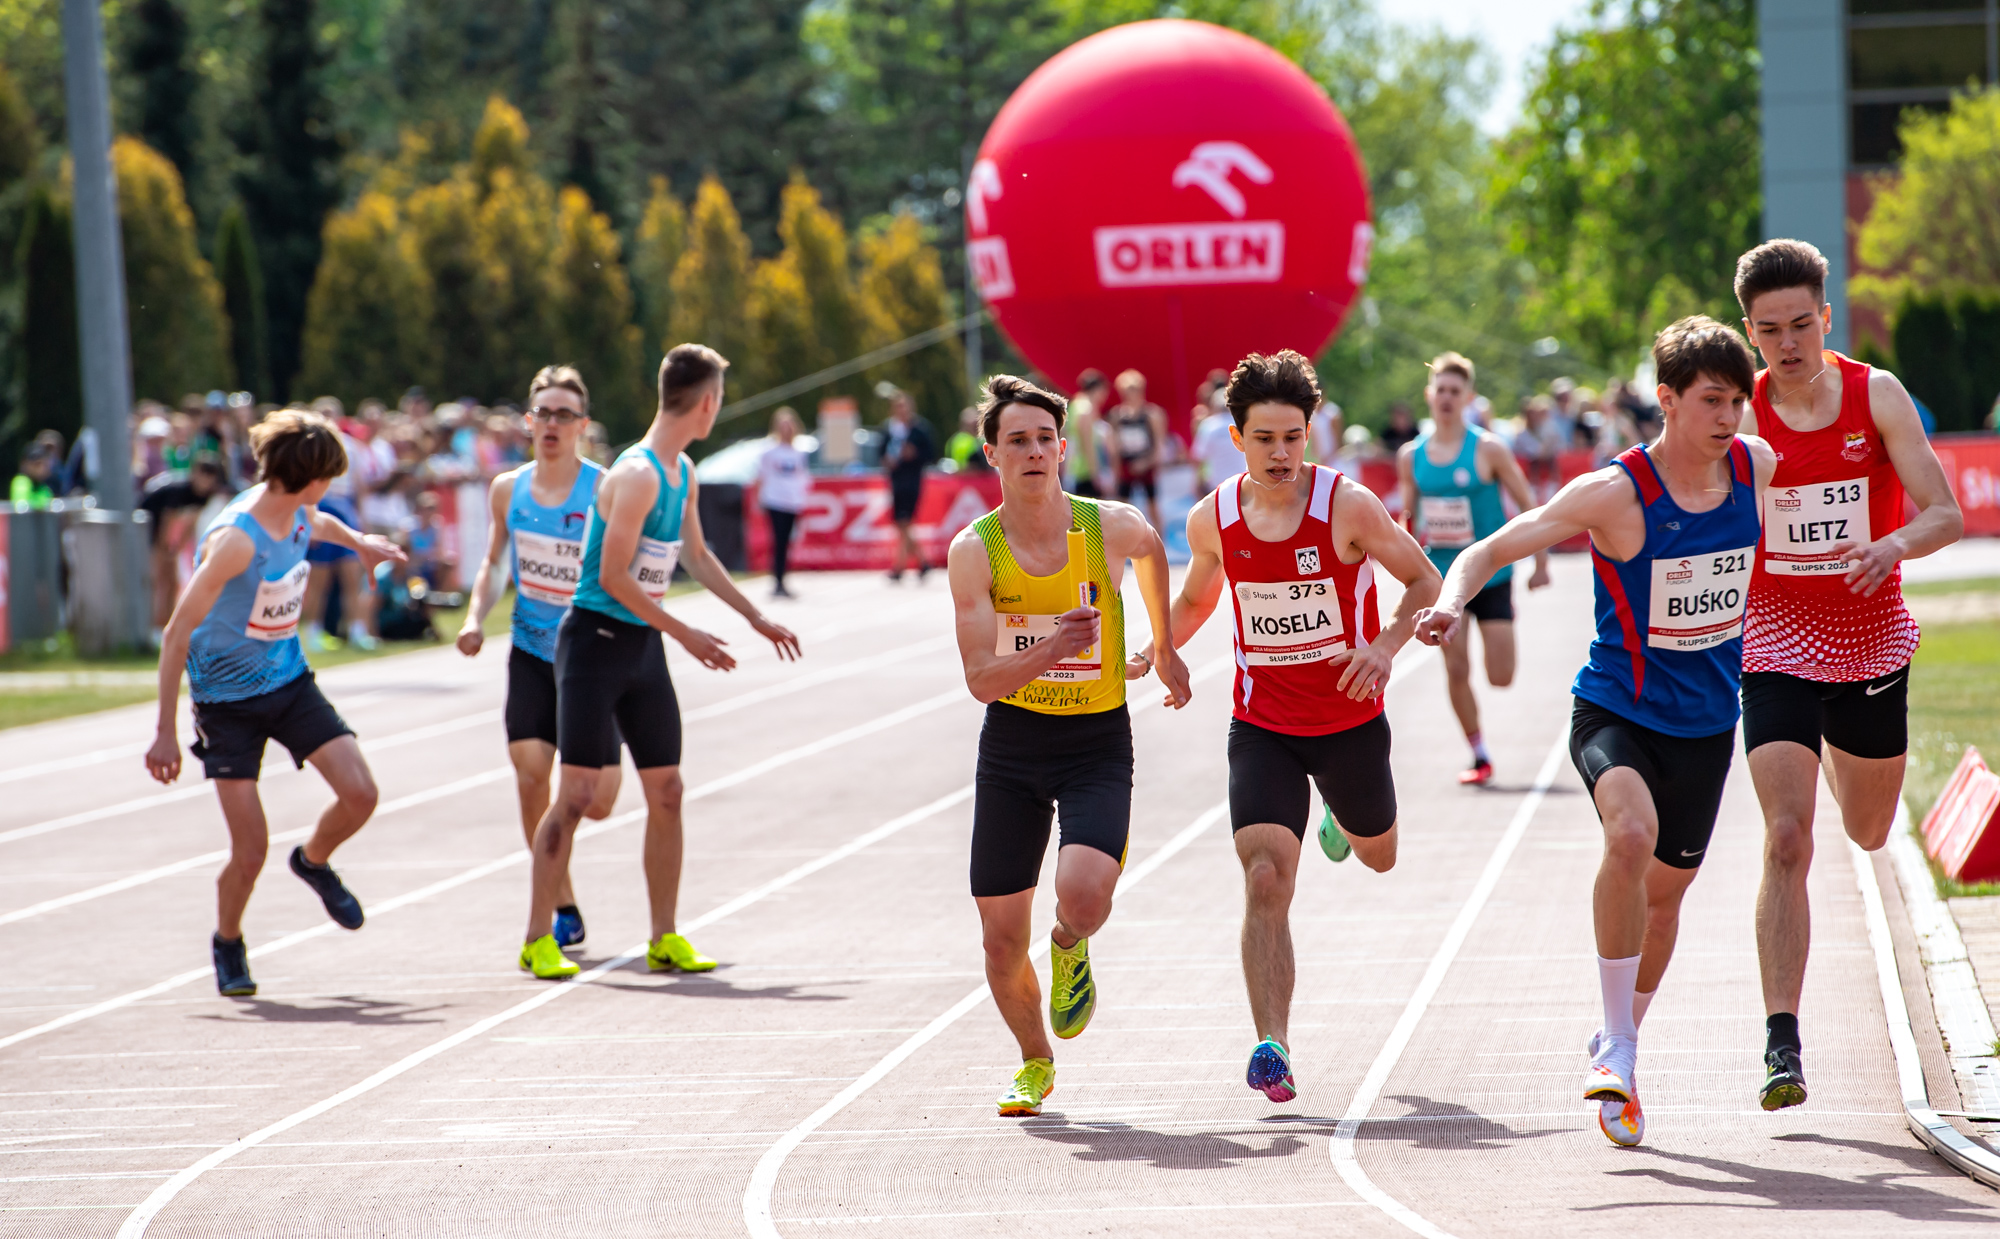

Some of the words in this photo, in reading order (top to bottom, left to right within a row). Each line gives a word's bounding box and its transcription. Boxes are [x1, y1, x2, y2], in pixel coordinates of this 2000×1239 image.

[1110, 233, 1269, 274] ORLEN
[1822, 484, 1861, 505] 513
[1776, 499, 1800, 507] ORLEN
[1788, 519, 1849, 543] LIETZ
[1712, 553, 1747, 576] 521
[1791, 563, 1826, 572] SŁUPSK
[1827, 562, 1850, 570] 2023
[1667, 571, 1692, 580] ORLEN
[1000, 594, 1022, 604] esa
[1252, 591, 1278, 600] Słupsk
[1288, 583, 1327, 600] 373
[1667, 588, 1740, 617] BUŚKO
[1251, 609, 1332, 635] KOSELA
[1677, 637, 1710, 647] SŁUPSK
[1268, 654, 1300, 662] SŁUPSK
[1300, 650, 1322, 660] 2023
[1025, 682, 1085, 698] POWIAT
[1023, 690, 1090, 707] WIELICKI
